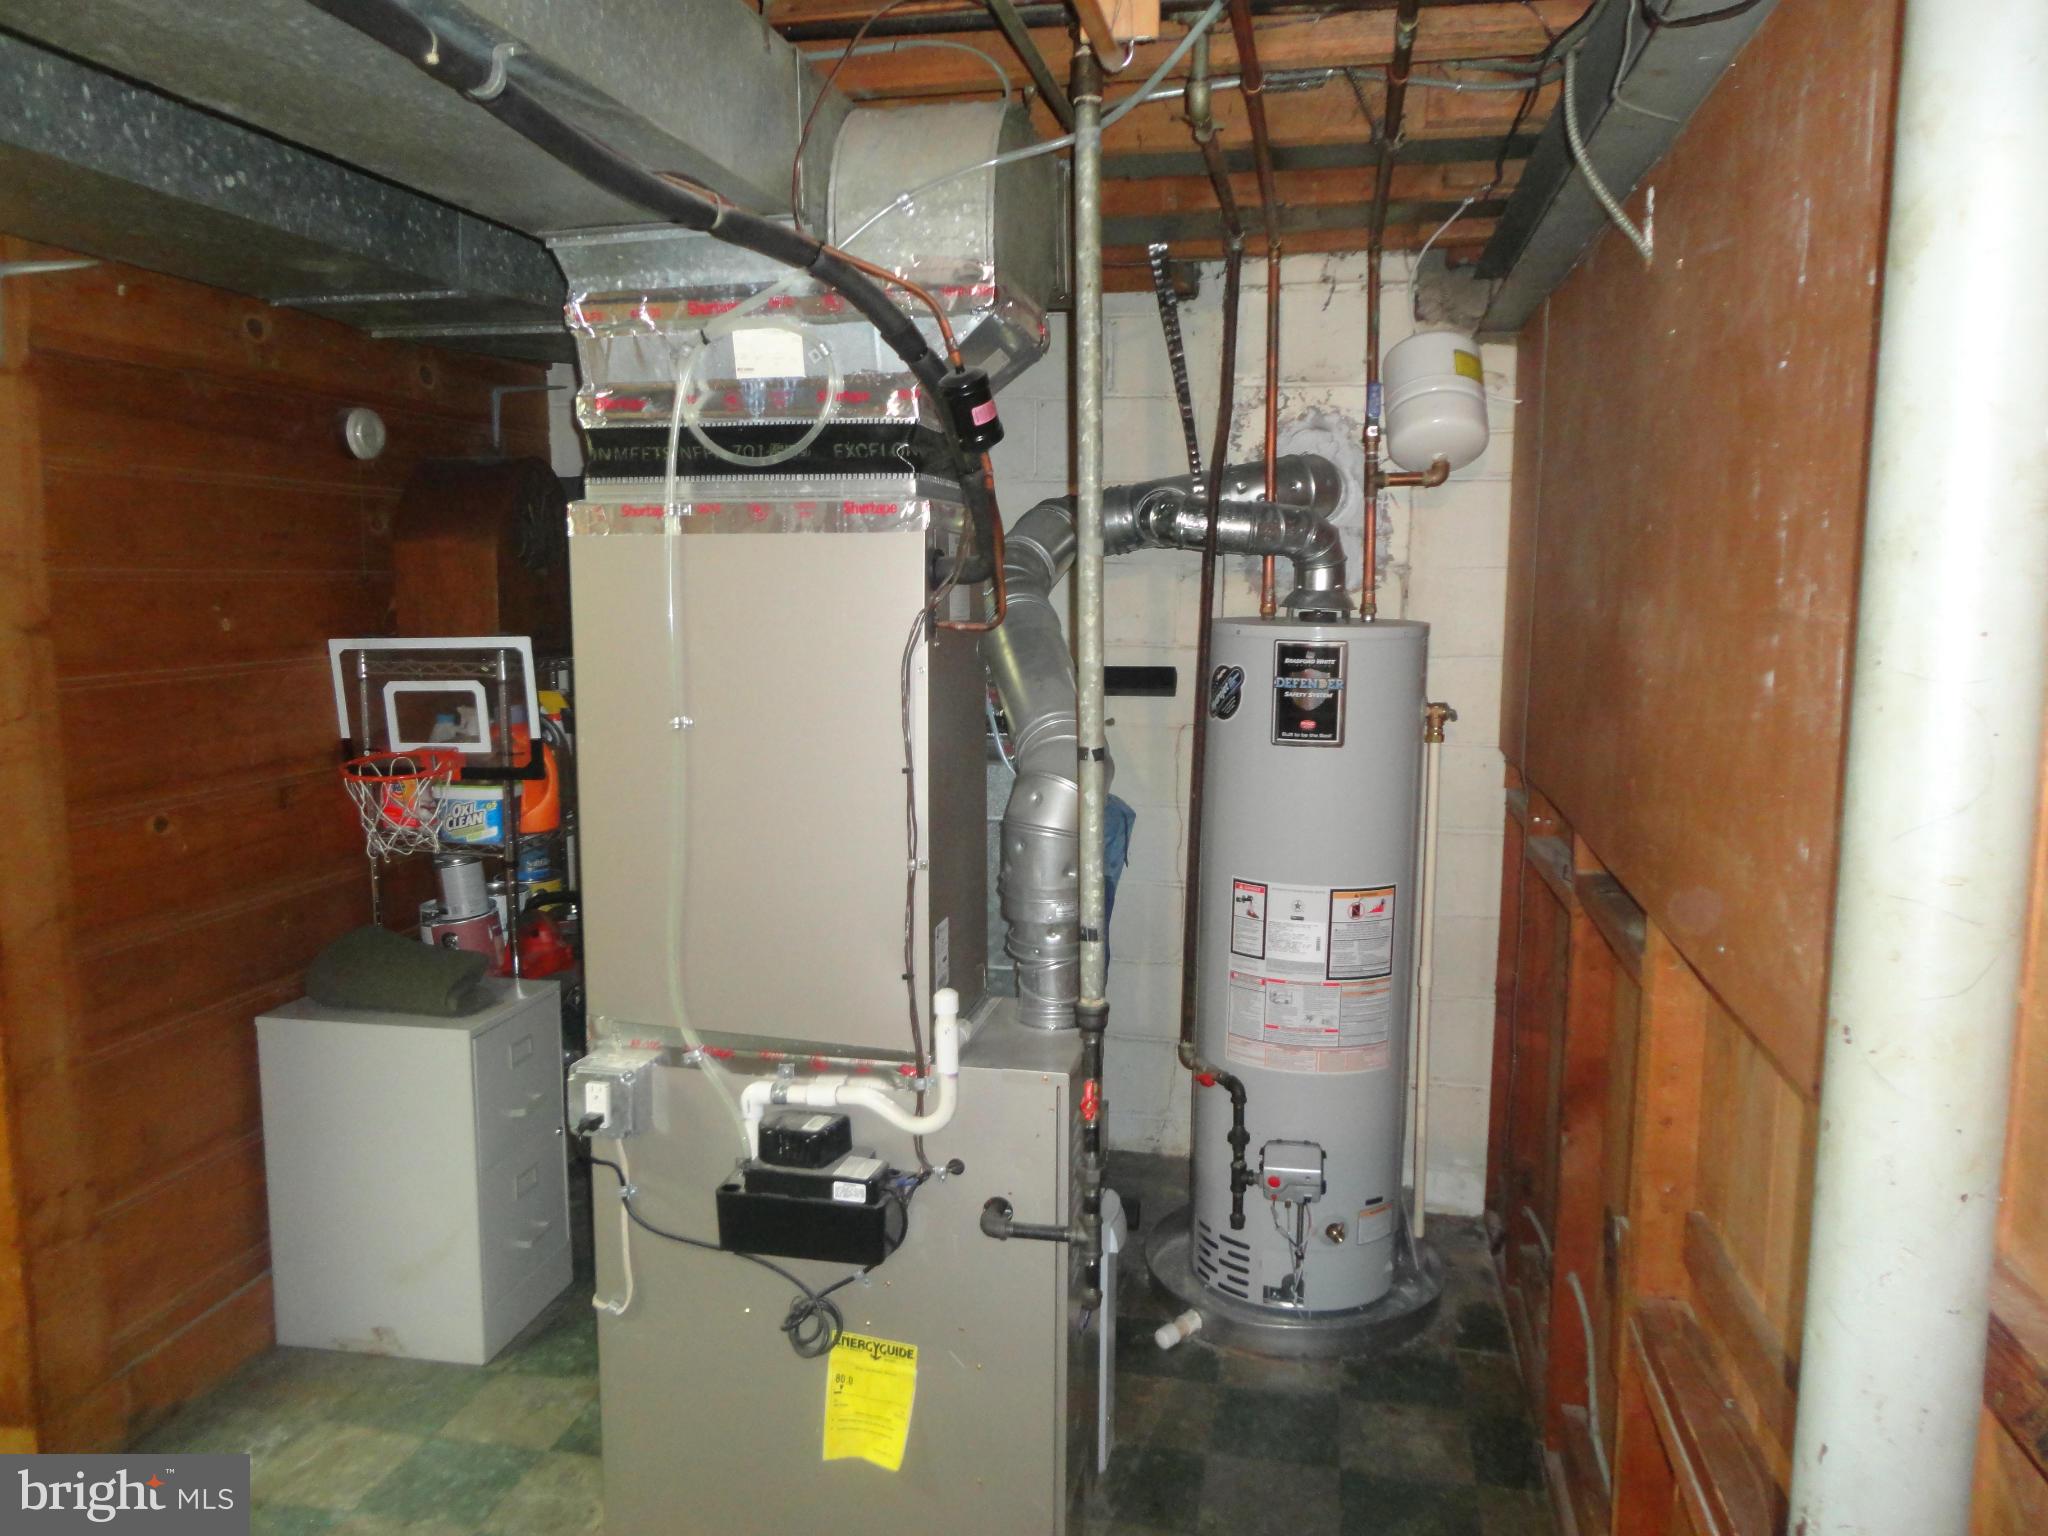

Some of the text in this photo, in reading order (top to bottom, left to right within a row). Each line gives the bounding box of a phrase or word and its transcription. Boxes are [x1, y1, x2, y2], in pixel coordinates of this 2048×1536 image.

[844, 500, 897, 515] Shurtape
[1275, 677, 1345, 690] DEFENDER
[452, 802, 474, 817] OXI
[446, 812, 484, 831] CLEAN
